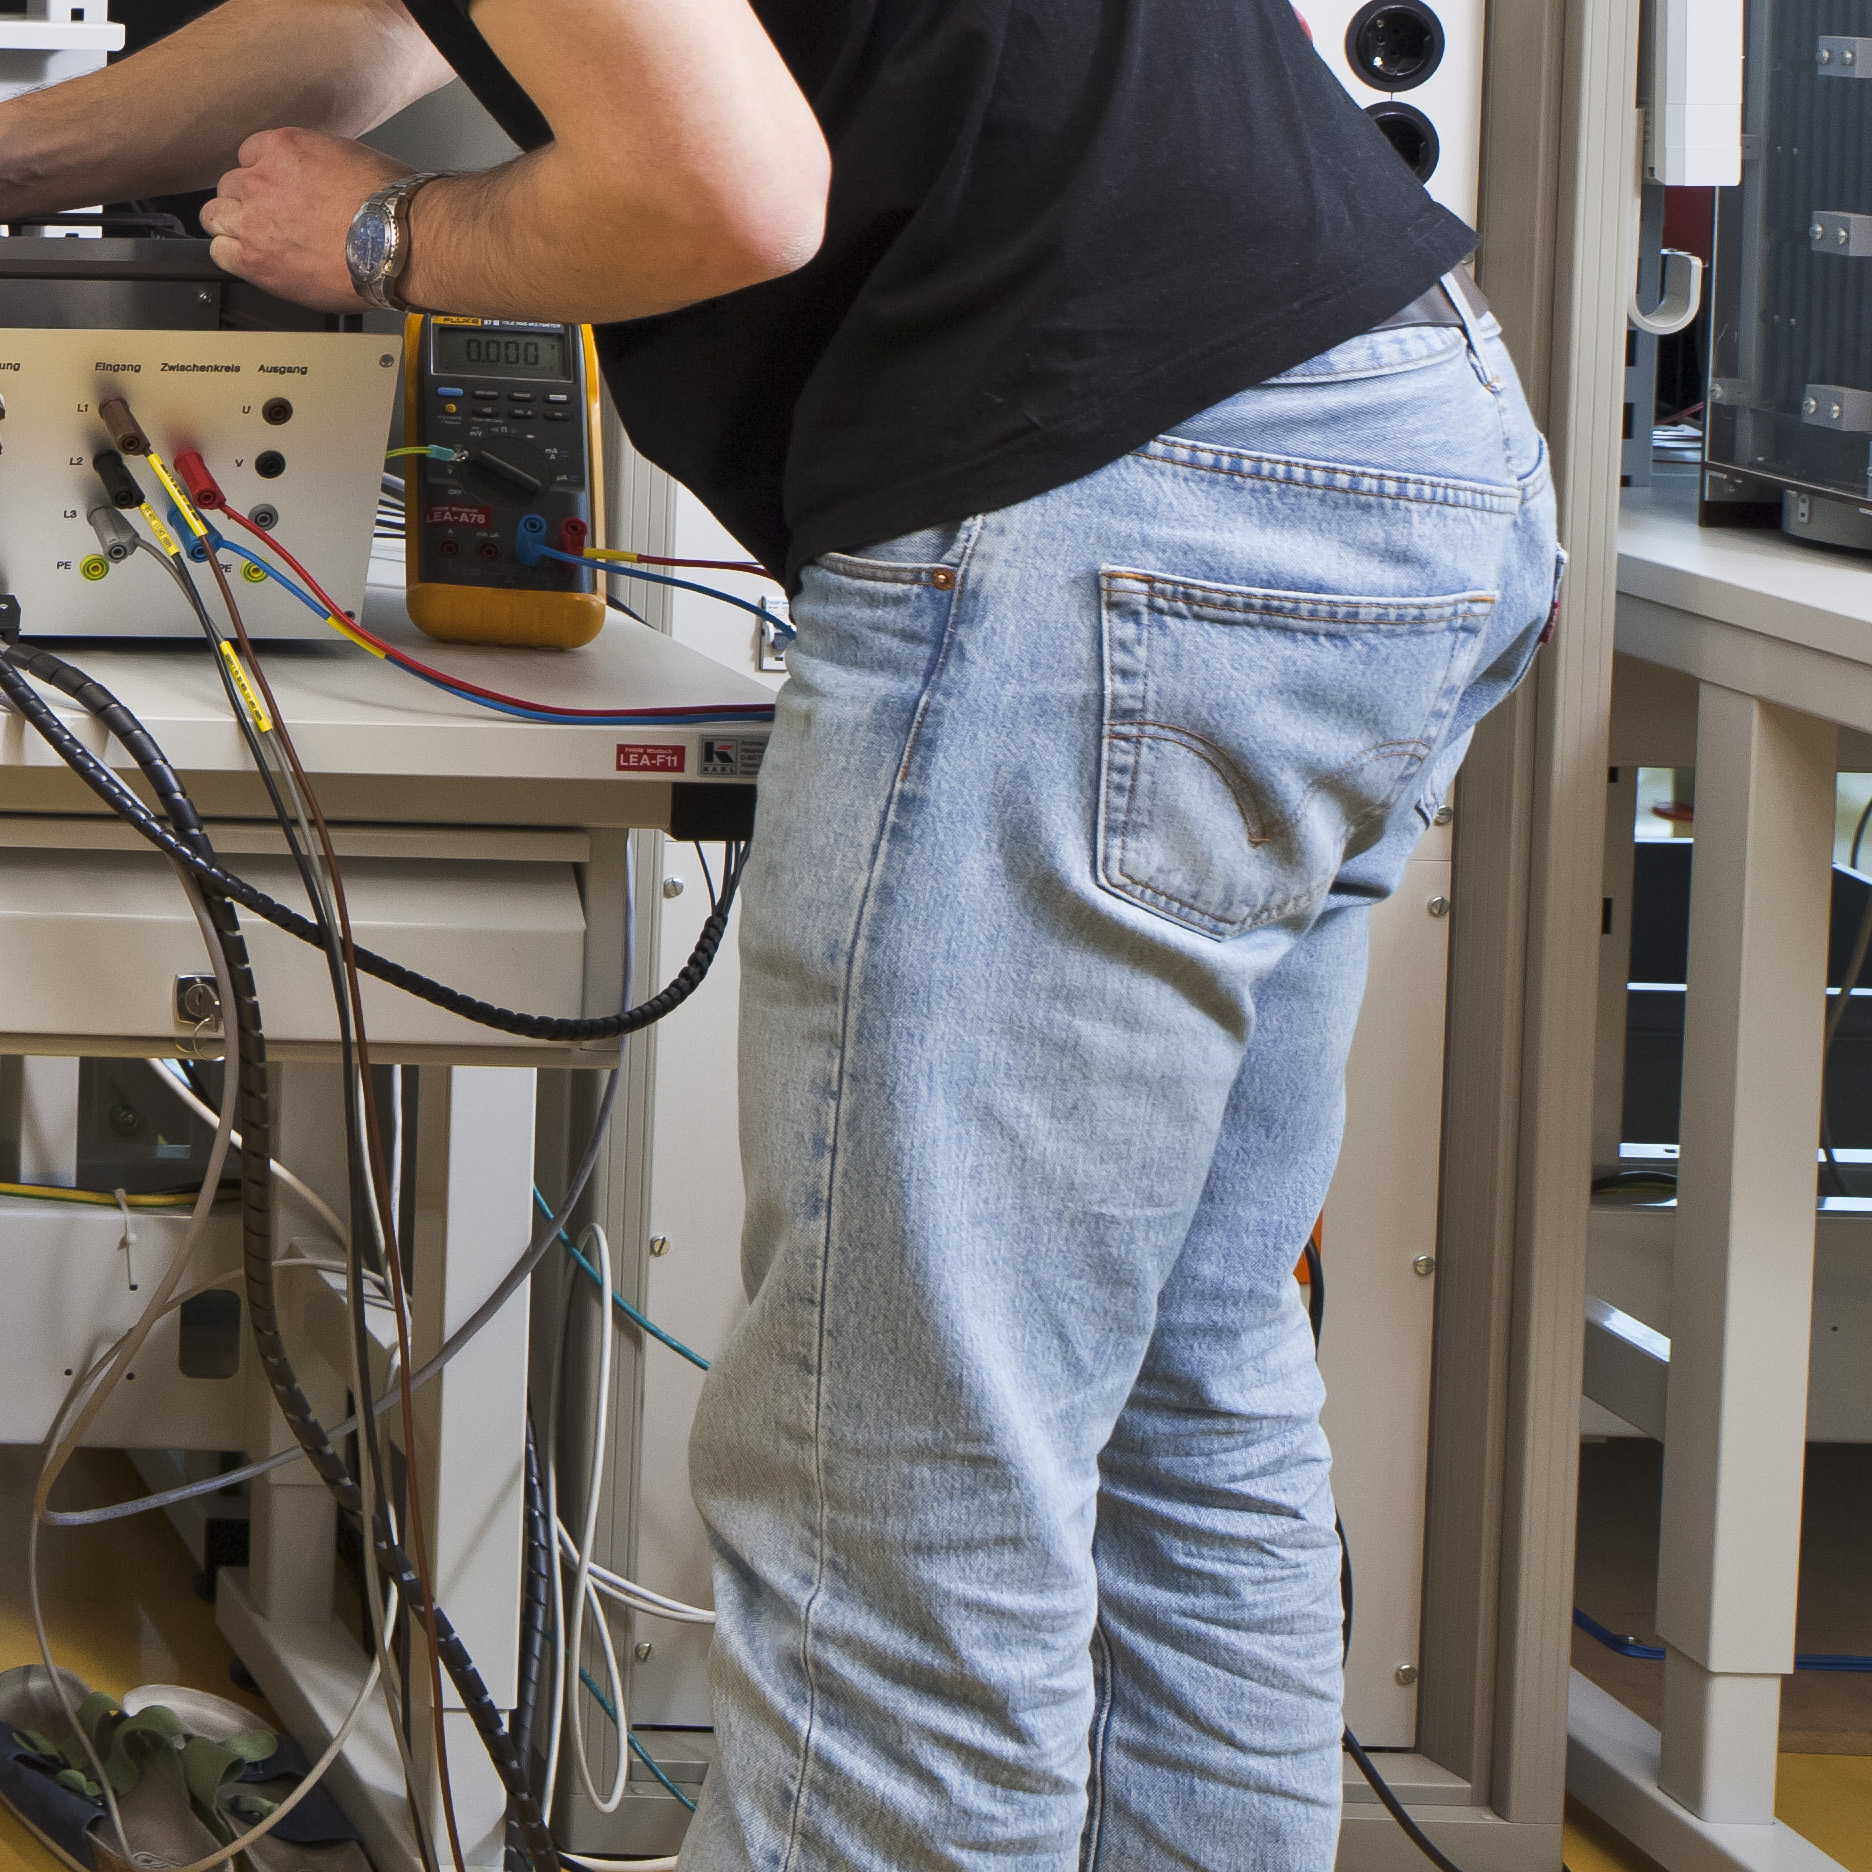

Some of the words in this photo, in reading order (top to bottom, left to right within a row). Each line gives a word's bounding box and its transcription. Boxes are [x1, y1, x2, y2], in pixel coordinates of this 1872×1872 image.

[443, 317, 479, 325] FLUKE
[95, 362, 142, 373] Eingang
[160, 363, 241, 373] Zwischenkreis
[257, 363, 308, 375] Ausgang
[77, 403, 88, 413] L1
[241, 405, 251, 414] U
[69, 457, 83, 466] L2
[234, 458, 243, 467] V
[63, 509, 77, 519] L3
[426, 511, 486, 524] LEA-A78
[56, 561, 72, 570] PE
[620, 753, 678, 767] LEA-F11
